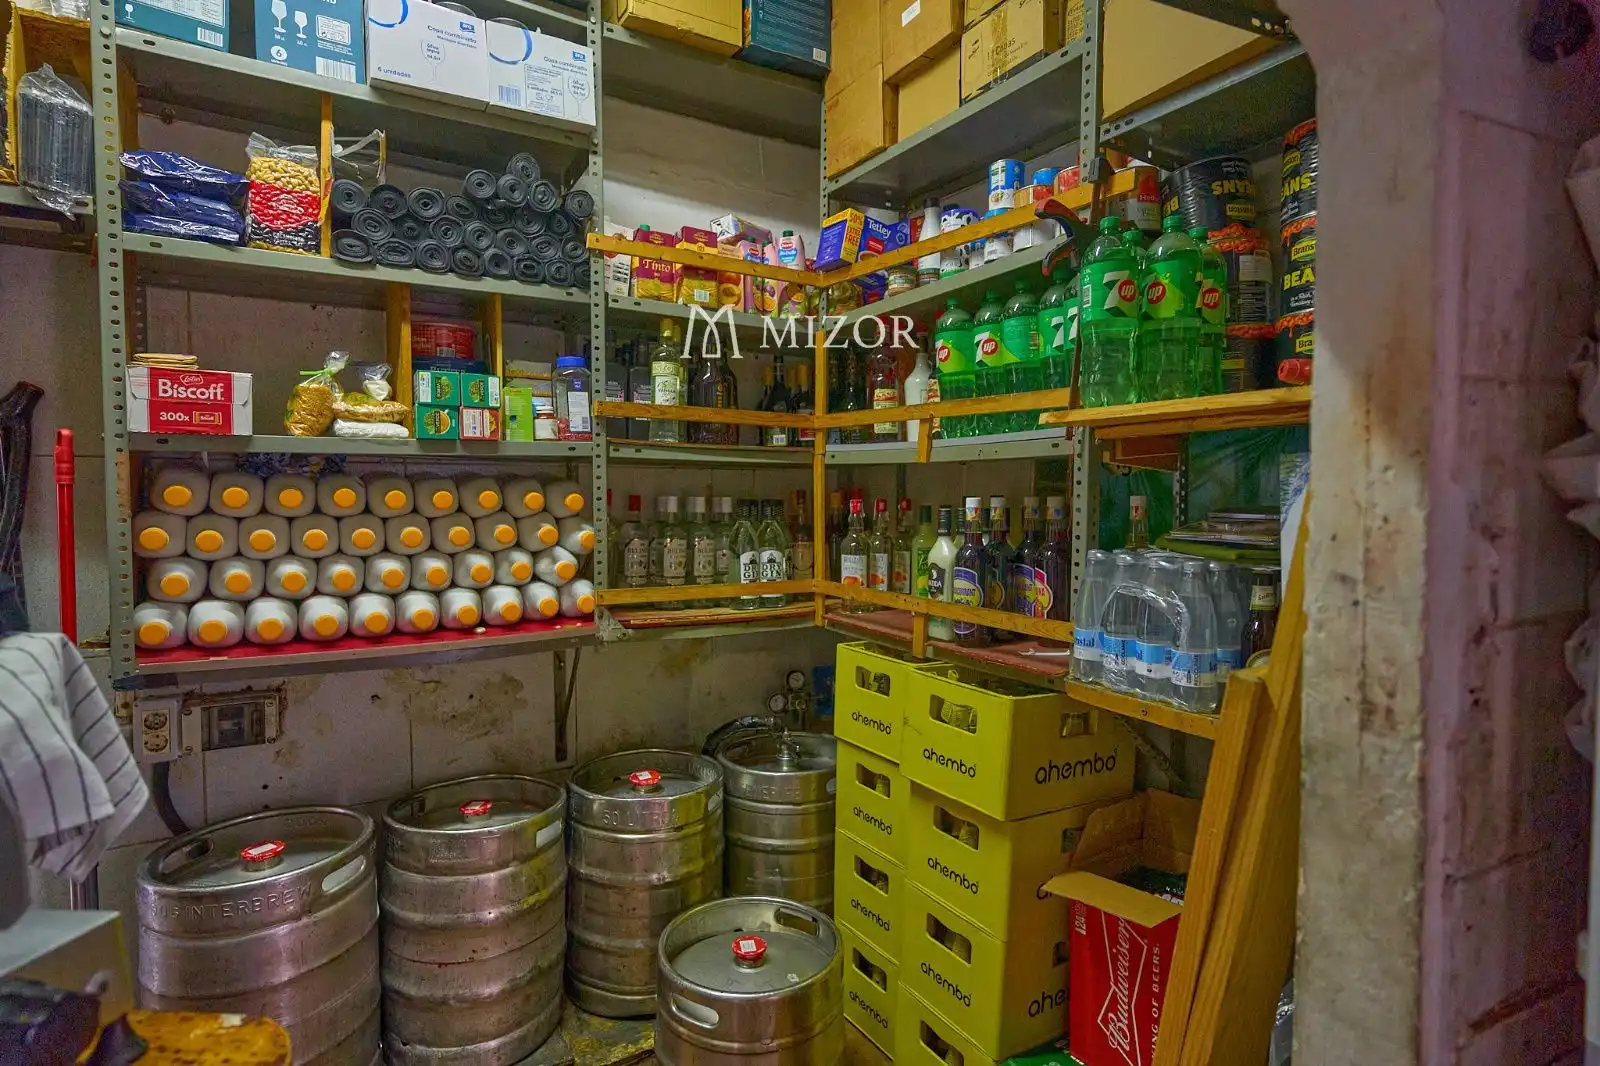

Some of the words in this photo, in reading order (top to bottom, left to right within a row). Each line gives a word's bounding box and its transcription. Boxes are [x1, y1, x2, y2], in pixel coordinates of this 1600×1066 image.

[867, 218, 892, 239] Tetley
[643, 259, 671, 272] Tinto
[158, 378, 224, 401] Biscoff
[160, 412, 190, 422] 300x
[761, 570, 781, 578] GIN
[852, 711, 892, 735] ahembo
[923, 748, 976, 778] ahembo
[1035, 752, 1117, 785] ahembo
[853, 806, 892, 836] ahembo
[927, 857, 979, 895] ahembo
[851, 898, 890, 932] ahembo
[920, 961, 971, 1008] ahembo
[1107, 916, 1131, 1052] Budweiser
[849, 990, 888, 1029] ahembo
[1152, 997, 1159, 1018] OF
